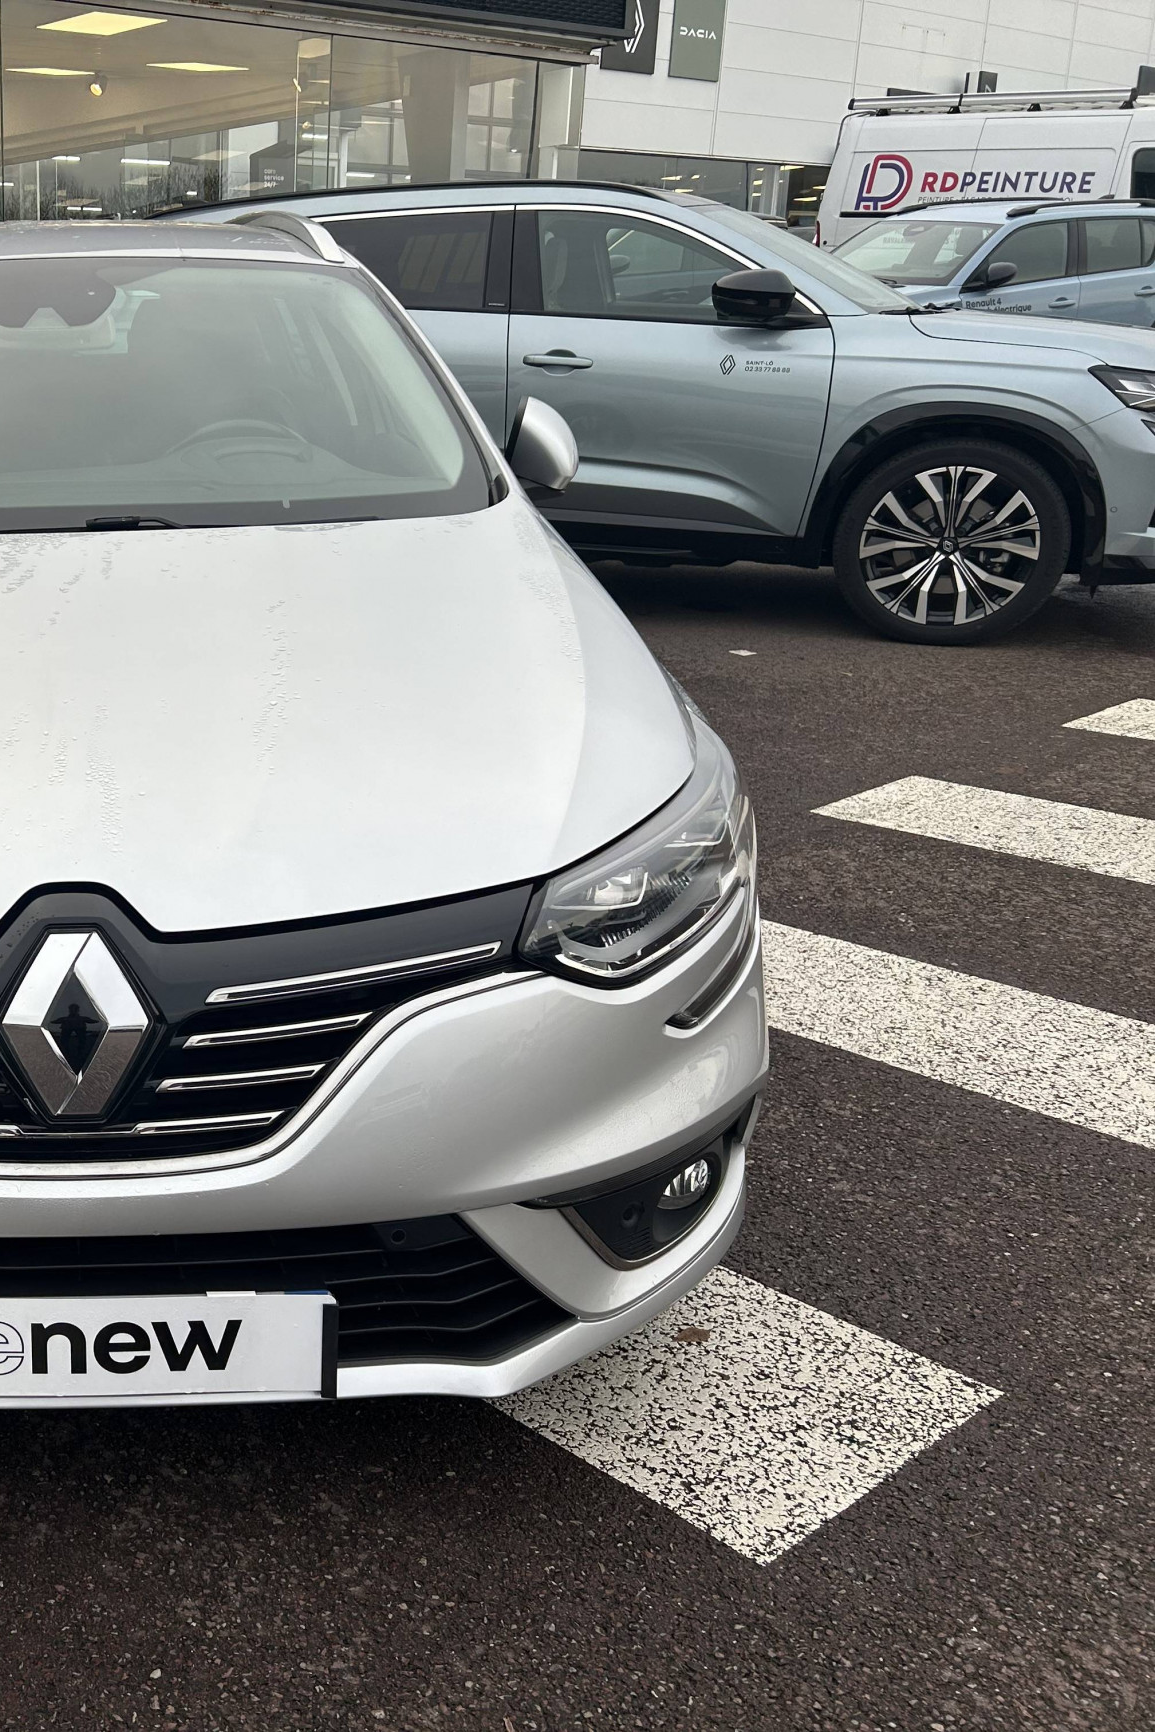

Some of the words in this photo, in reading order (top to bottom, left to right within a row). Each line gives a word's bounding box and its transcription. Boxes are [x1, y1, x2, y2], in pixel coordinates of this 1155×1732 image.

[679, 26, 717, 40] DACIA
[965, 298, 996, 308] Renault
[996, 297, 1002, 305] 4
